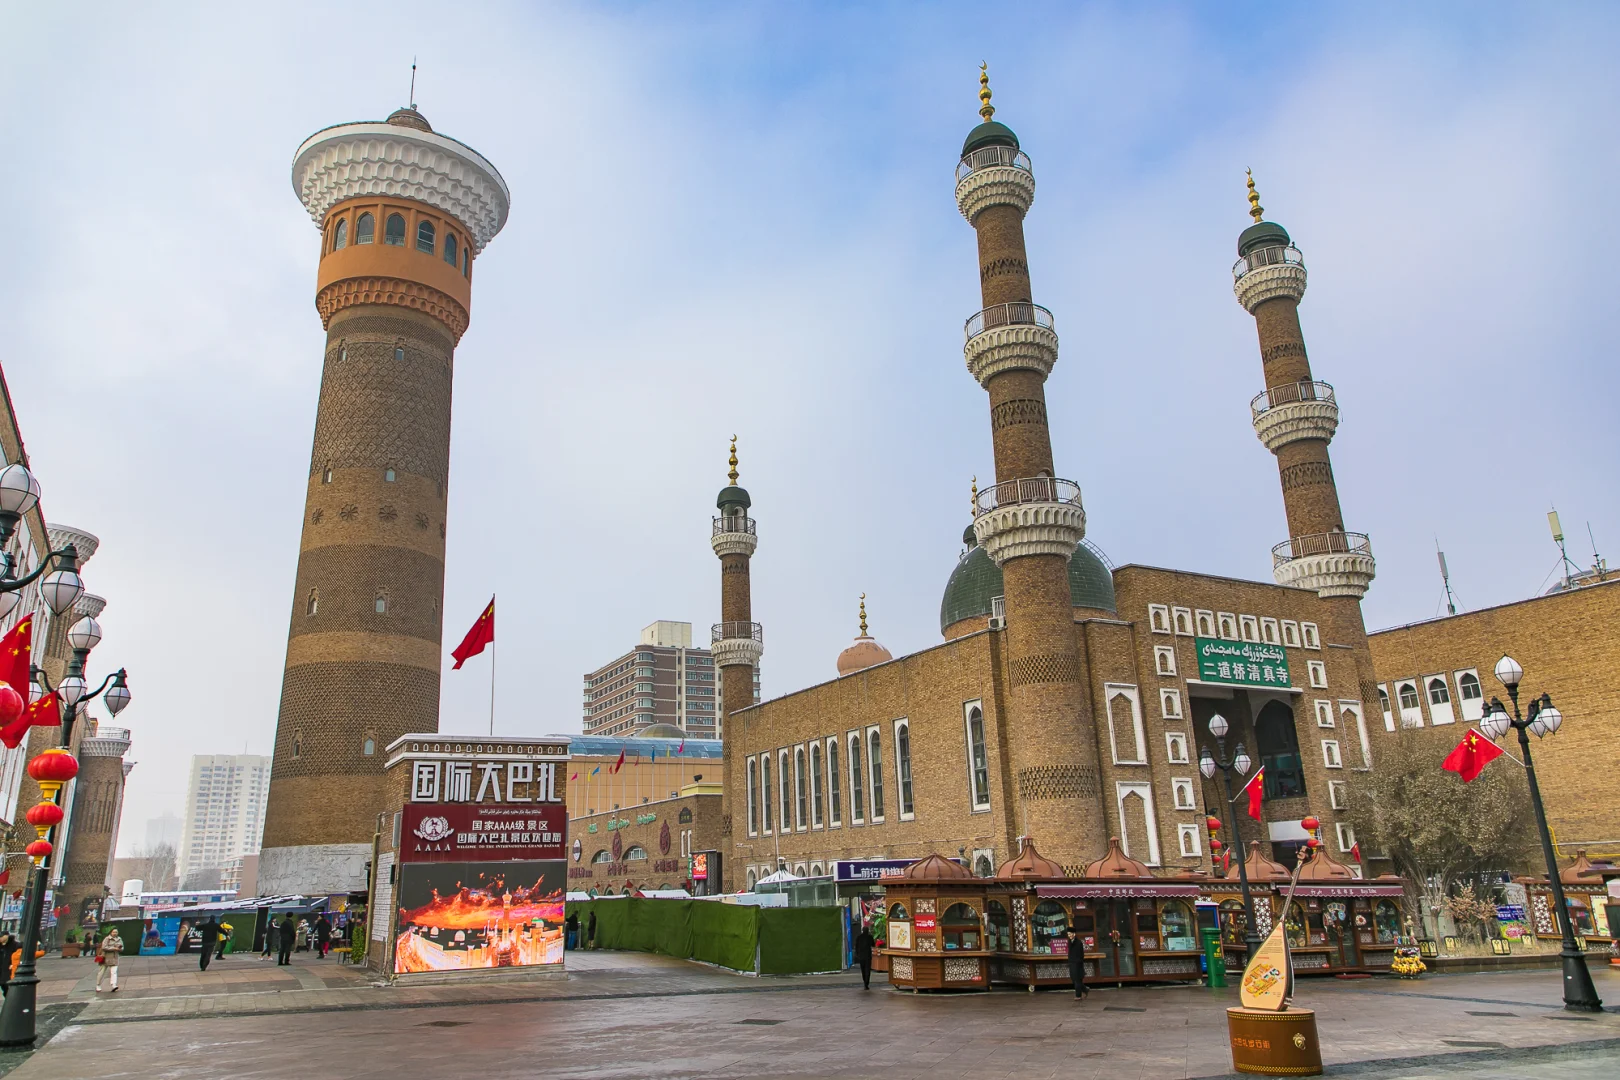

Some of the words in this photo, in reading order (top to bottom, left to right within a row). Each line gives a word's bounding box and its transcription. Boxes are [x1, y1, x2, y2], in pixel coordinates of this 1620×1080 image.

[1204, 661, 1288, 683] 二道桥清真寺
[411, 760, 561, 803] 国际大巴扎
[457, 832, 562, 843] 国际大巴扎景区欢迎您
